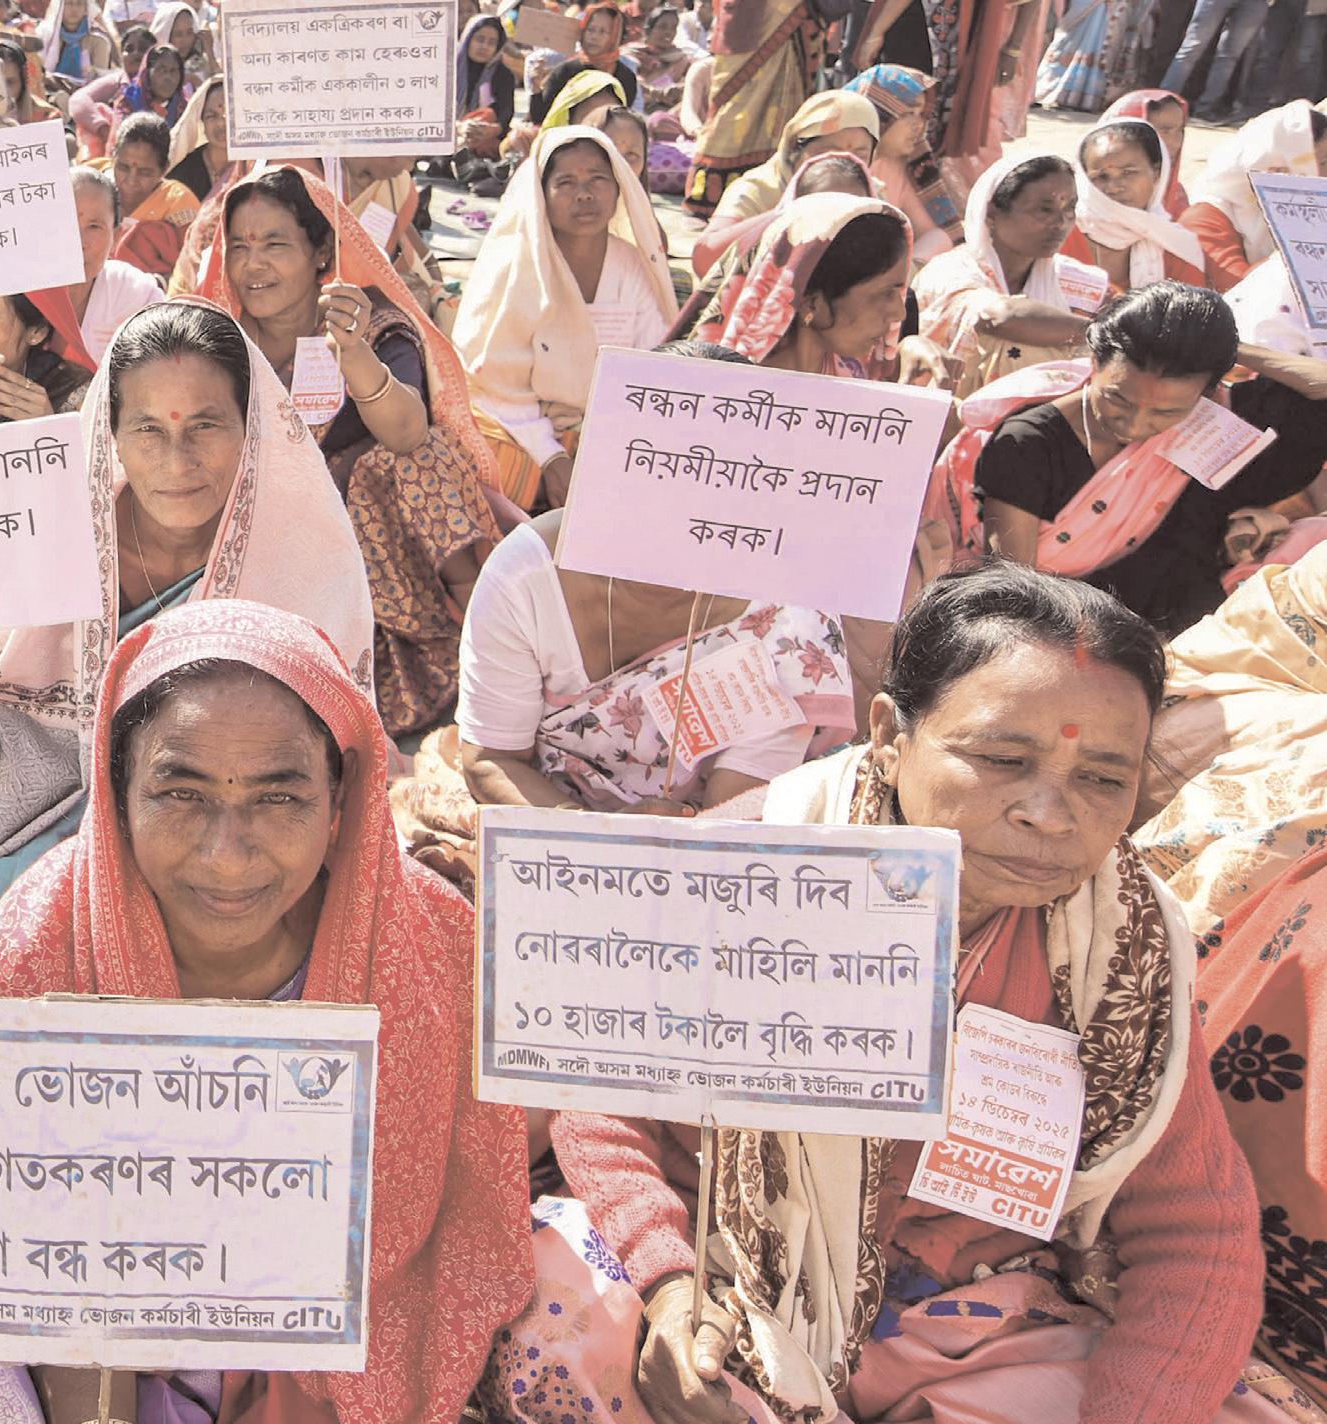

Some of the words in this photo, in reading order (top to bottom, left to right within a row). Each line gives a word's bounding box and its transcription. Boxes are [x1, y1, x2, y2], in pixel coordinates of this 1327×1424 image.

[242, 53, 270, 66] অন্য
[336, 48, 365, 61] কাম
[322, 73, 389, 91] এককালীন
[395, 78, 405, 89] ৩
[410, 75, 439, 89] লাখ
[417, 127, 443, 137] CITU
[21, 182, 55, 203] টকা
[626, 384, 705, 419] ৰন্ধন
[815, 408, 912, 445] মাননি
[510, 850, 671, 898] আইনমতে
[712, 938, 817, 985] মাহিলি
[829, 944, 920, 987] মাননি
[514, 1000, 553, 1030] ১০
[562, 1003, 647, 1041] হাজাৰ
[655, 1001, 748, 1051] টকালৈ
[759, 1011, 813, 1063] বৃদ্ধি
[16, 1062, 140, 1108] ভোজন
[154, 1053, 271, 1113] আঁচনি
[557, 1056, 589, 1074] সদৌ
[595, 1062, 630, 1079] অসম
[635, 1063, 682, 1085] মধ্যাহ্ন
[687, 1068, 737, 1089] ভোজন
[801, 1073, 863, 1098] ইউনিয়ন
[870, 1081, 925, 1103] CITU
[958, 1092, 976, 1108] ১৪
[1035, 1116, 1069, 1139] ২০২৫
[190, 1153, 332, 1201] সকলো
[991, 1198, 1050, 1228] CITU
[24, 1238, 89, 1283] বন্ধ
[22, 1305, 74, 1328] মধ্যাহ্ন
[79, 1306, 135, 1328] ভোজন
[206, 1303, 275, 1329] ইউনিয়ন
[283, 1307, 343, 1331] CITU
